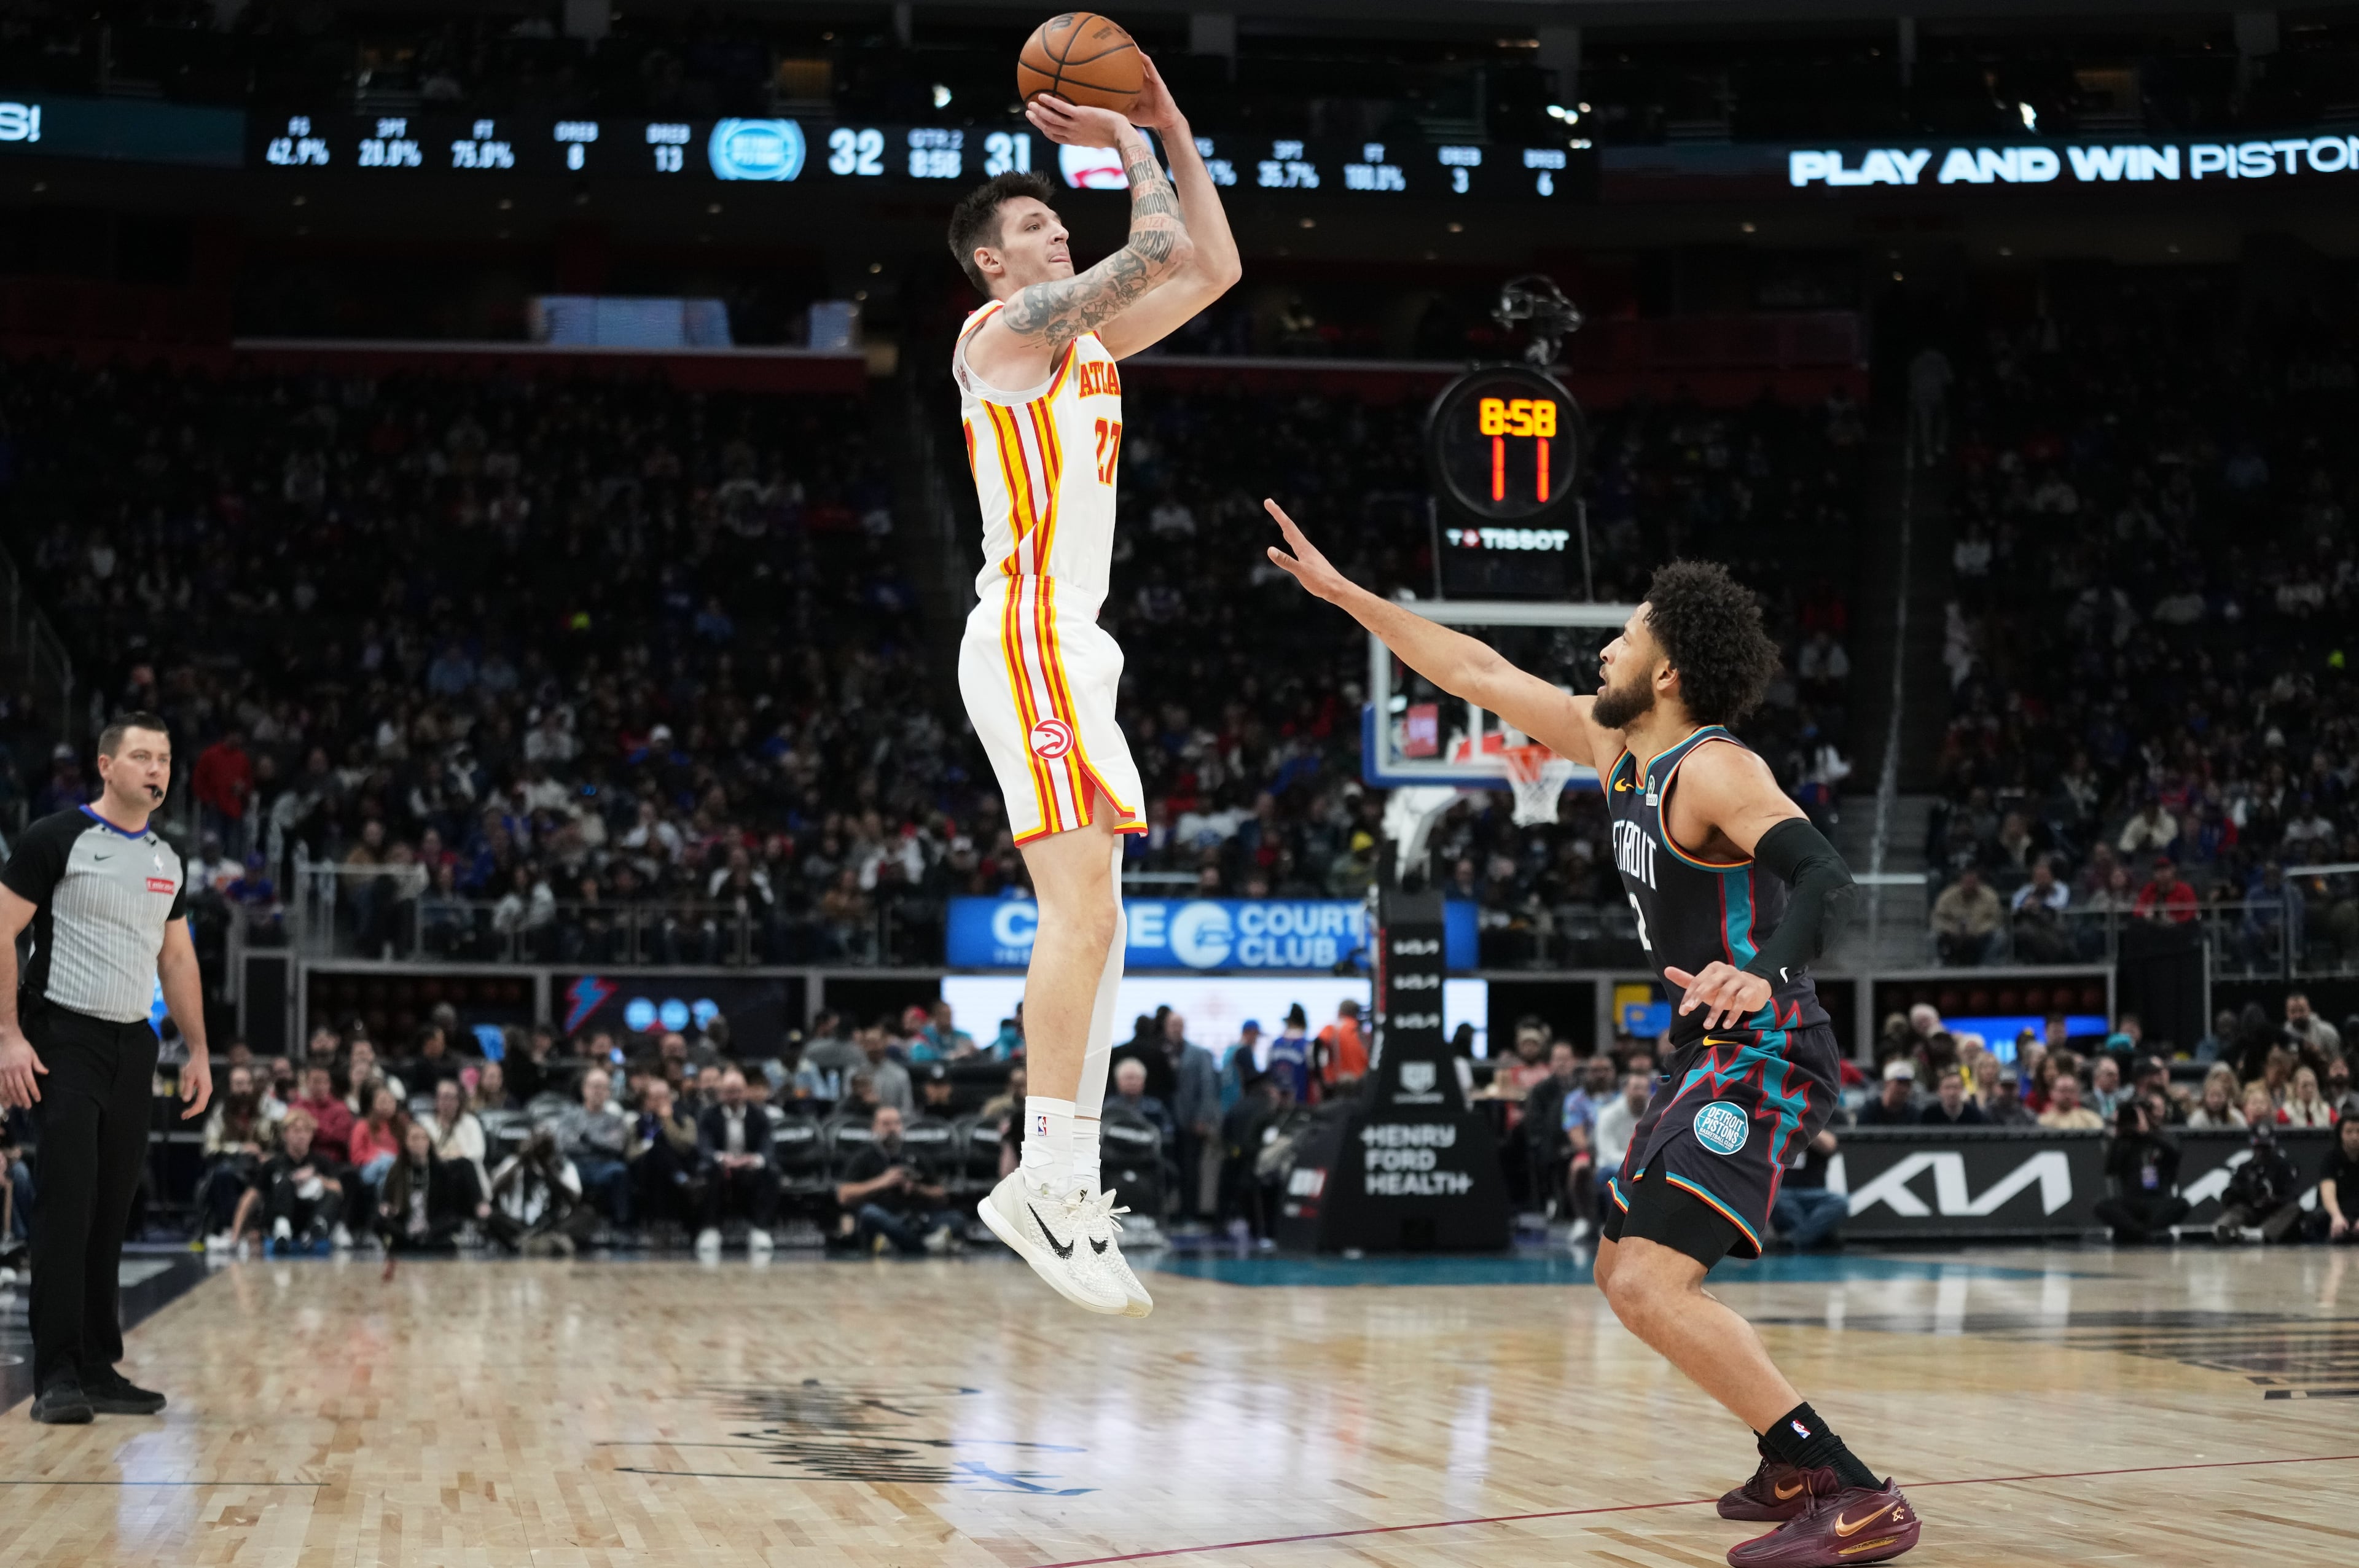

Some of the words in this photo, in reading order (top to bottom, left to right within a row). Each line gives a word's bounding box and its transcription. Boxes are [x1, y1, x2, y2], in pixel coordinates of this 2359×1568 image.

[0, 102, 41, 142] S!
[654, 145, 683, 172] 13
[829, 128, 884, 176] 32
[984, 131, 1031, 177] 31
[1789, 149, 1932, 186] PLAY
[1938, 146, 2060, 184] AND
[2067, 145, 2180, 181] WIN
[1452, 167, 1469, 193] 3
[1537, 171, 1554, 197] 6
[1479, 397, 1557, 437] 8:58
[1094, 416, 1122, 487] 27
[1492, 436, 1549, 502] 11
[1478, 527, 1570, 551] TISSOT
[1237, 904, 1366, 936] COURT
[1237, 937, 1337, 967] CLUB
[1702, 1117, 1739, 1144] PISTONS
[1707, 1106, 1745, 1132] DETROIT
[1360, 1123, 1456, 1148] HENRY
[1699, 1127, 1725, 1143] BASKETBALL
[1723, 1139, 1735, 1149] CLUB
[1365, 1149, 1436, 1171] FORD
[1849, 1151, 2072, 1216] KIA
